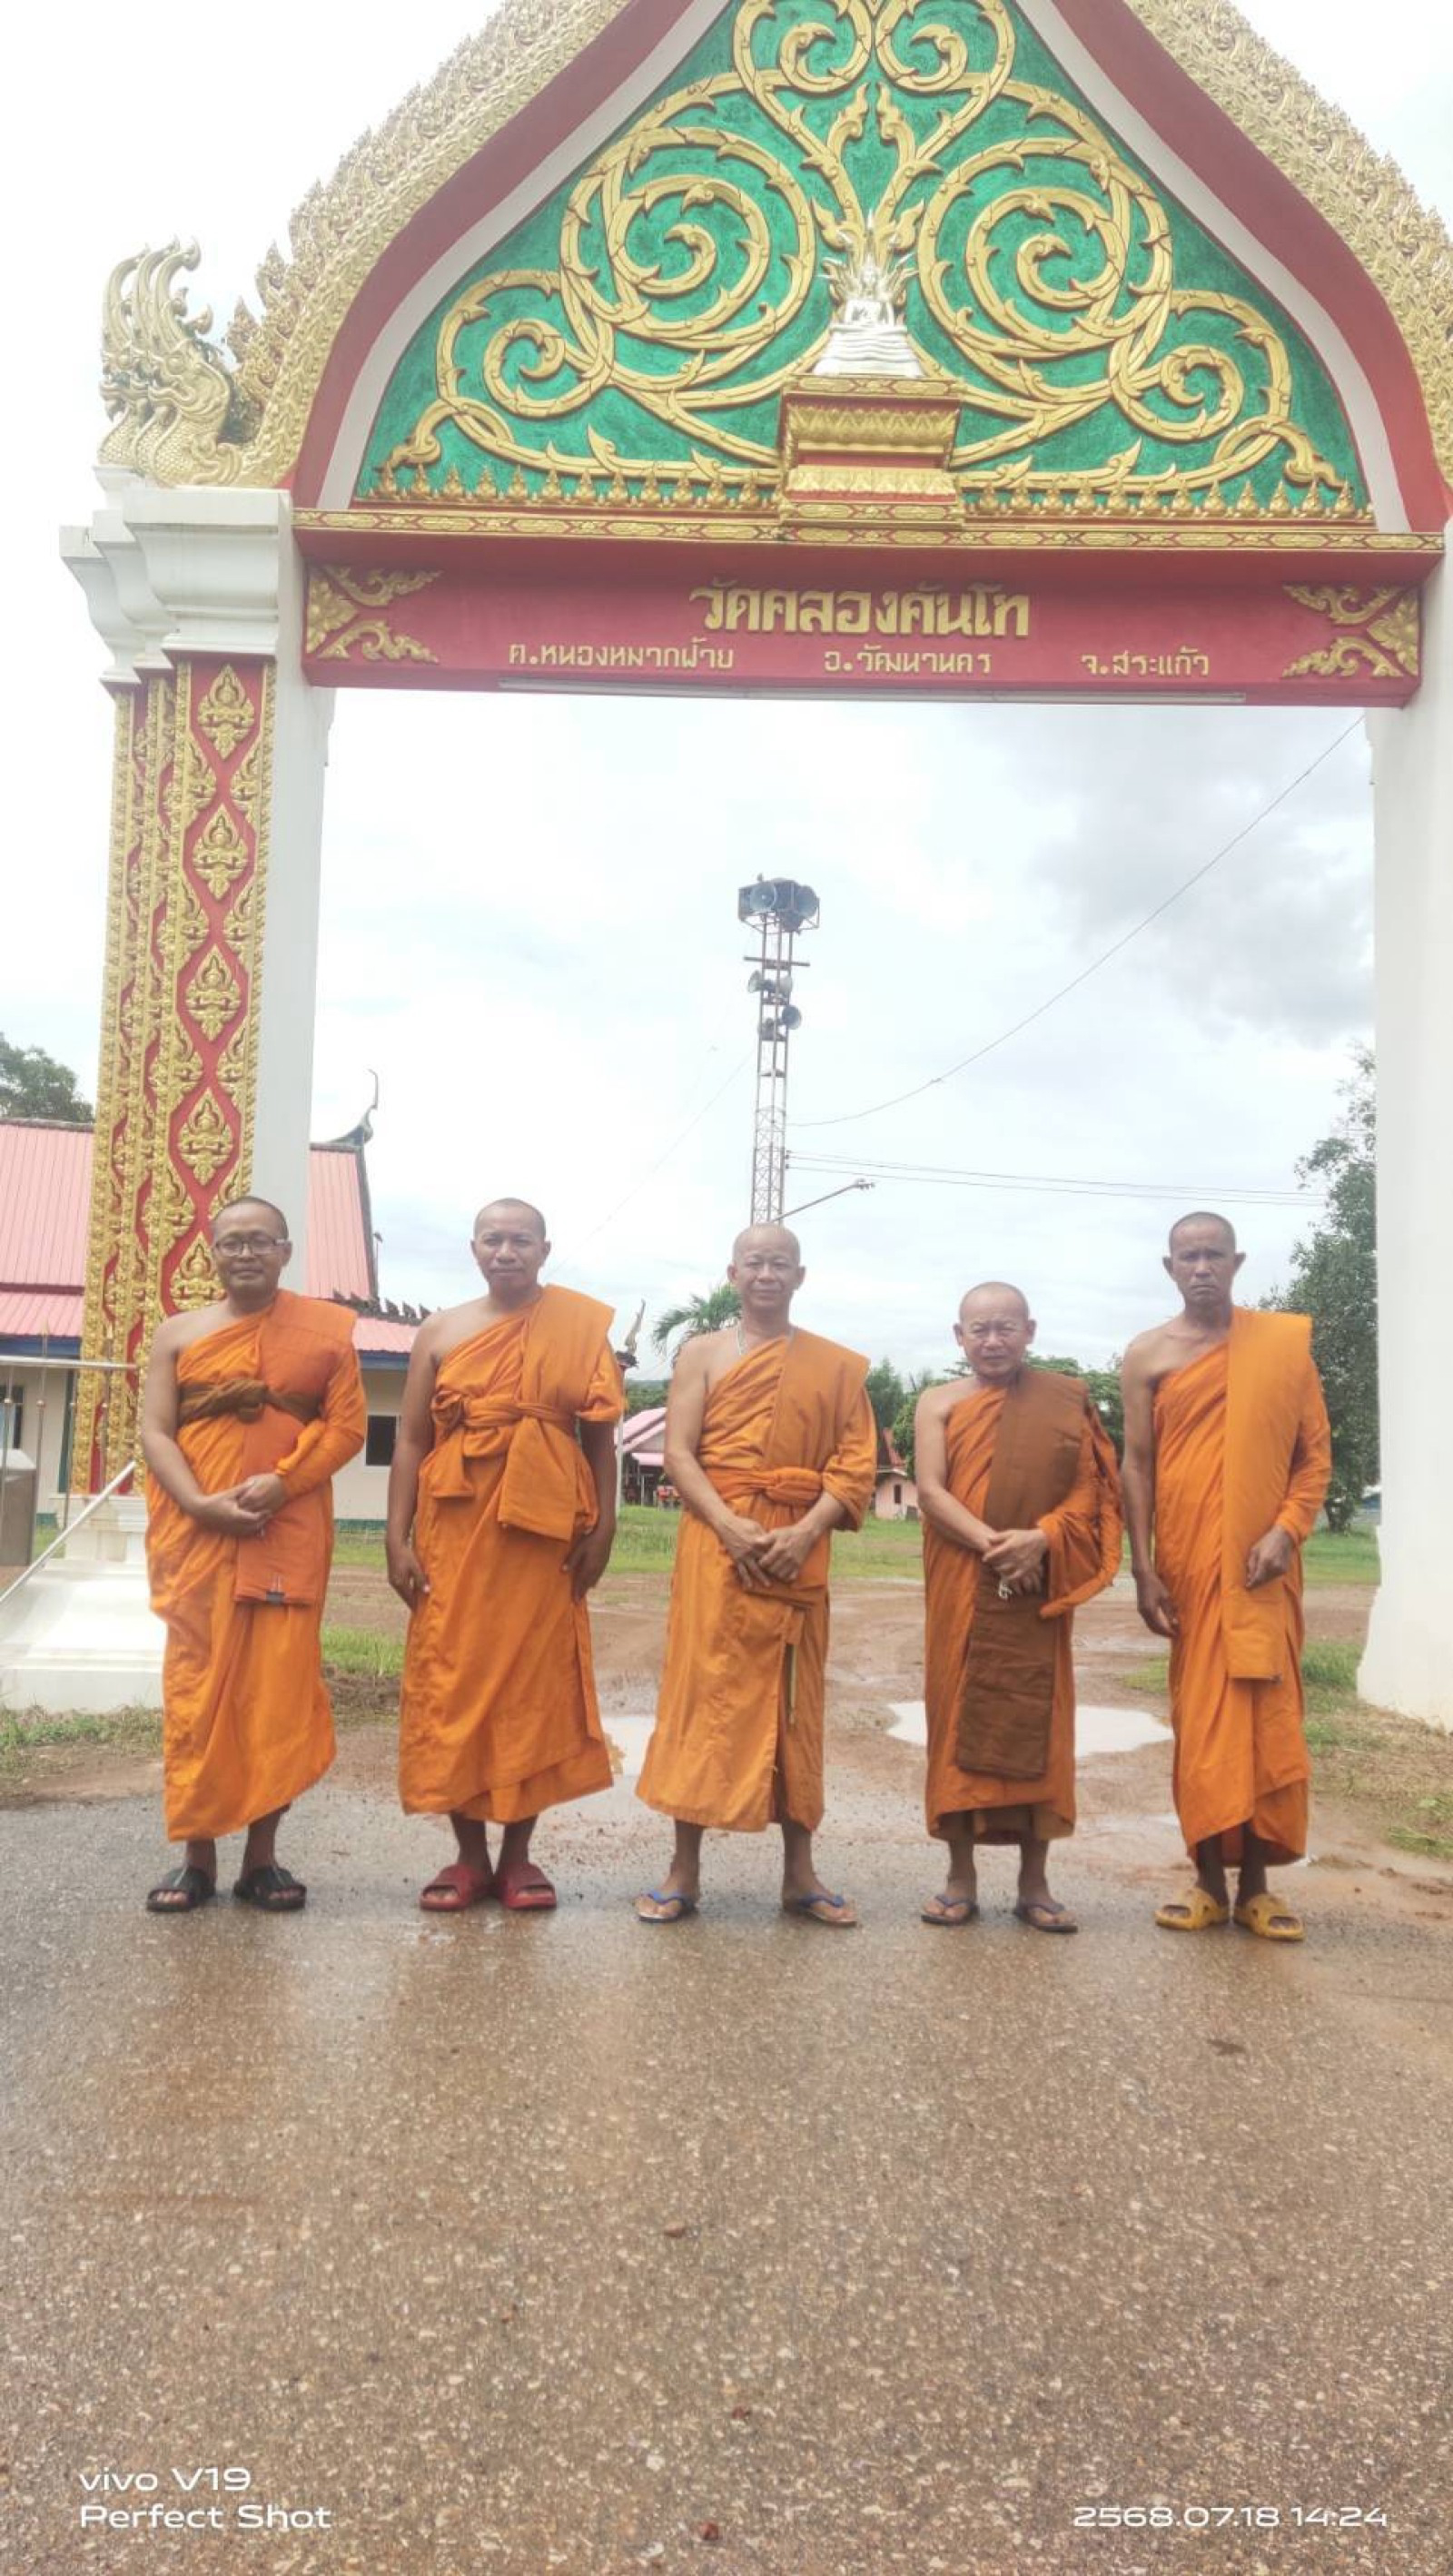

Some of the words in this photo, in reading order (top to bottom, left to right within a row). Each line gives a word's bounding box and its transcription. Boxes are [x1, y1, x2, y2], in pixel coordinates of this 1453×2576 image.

[689, 577, 1030, 637] วัดคลองคันโท
[824, 643, 993, 674] อ.วัฒนานคร
[1081, 646, 1211, 676] จ.สระแก้ว
